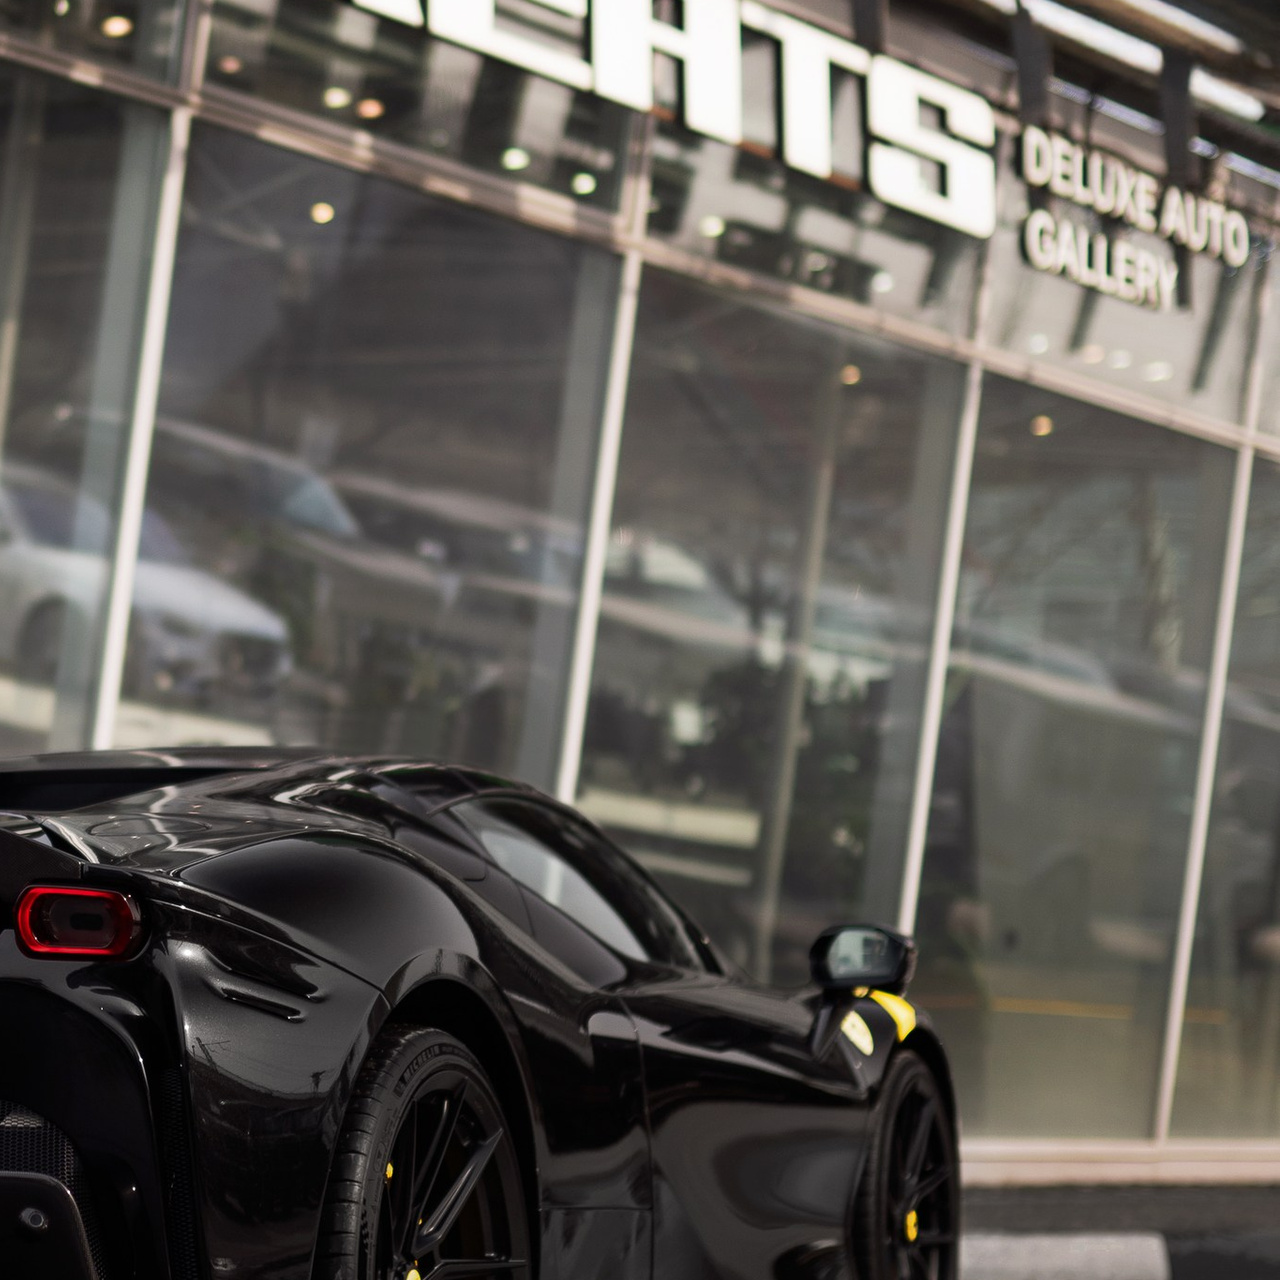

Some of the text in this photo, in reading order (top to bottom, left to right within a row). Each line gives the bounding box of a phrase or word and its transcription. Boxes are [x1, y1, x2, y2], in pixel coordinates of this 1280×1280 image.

[1023, 124, 1250, 267] DELUXE AUTO
[1025, 209, 1179, 311] GALLERY
